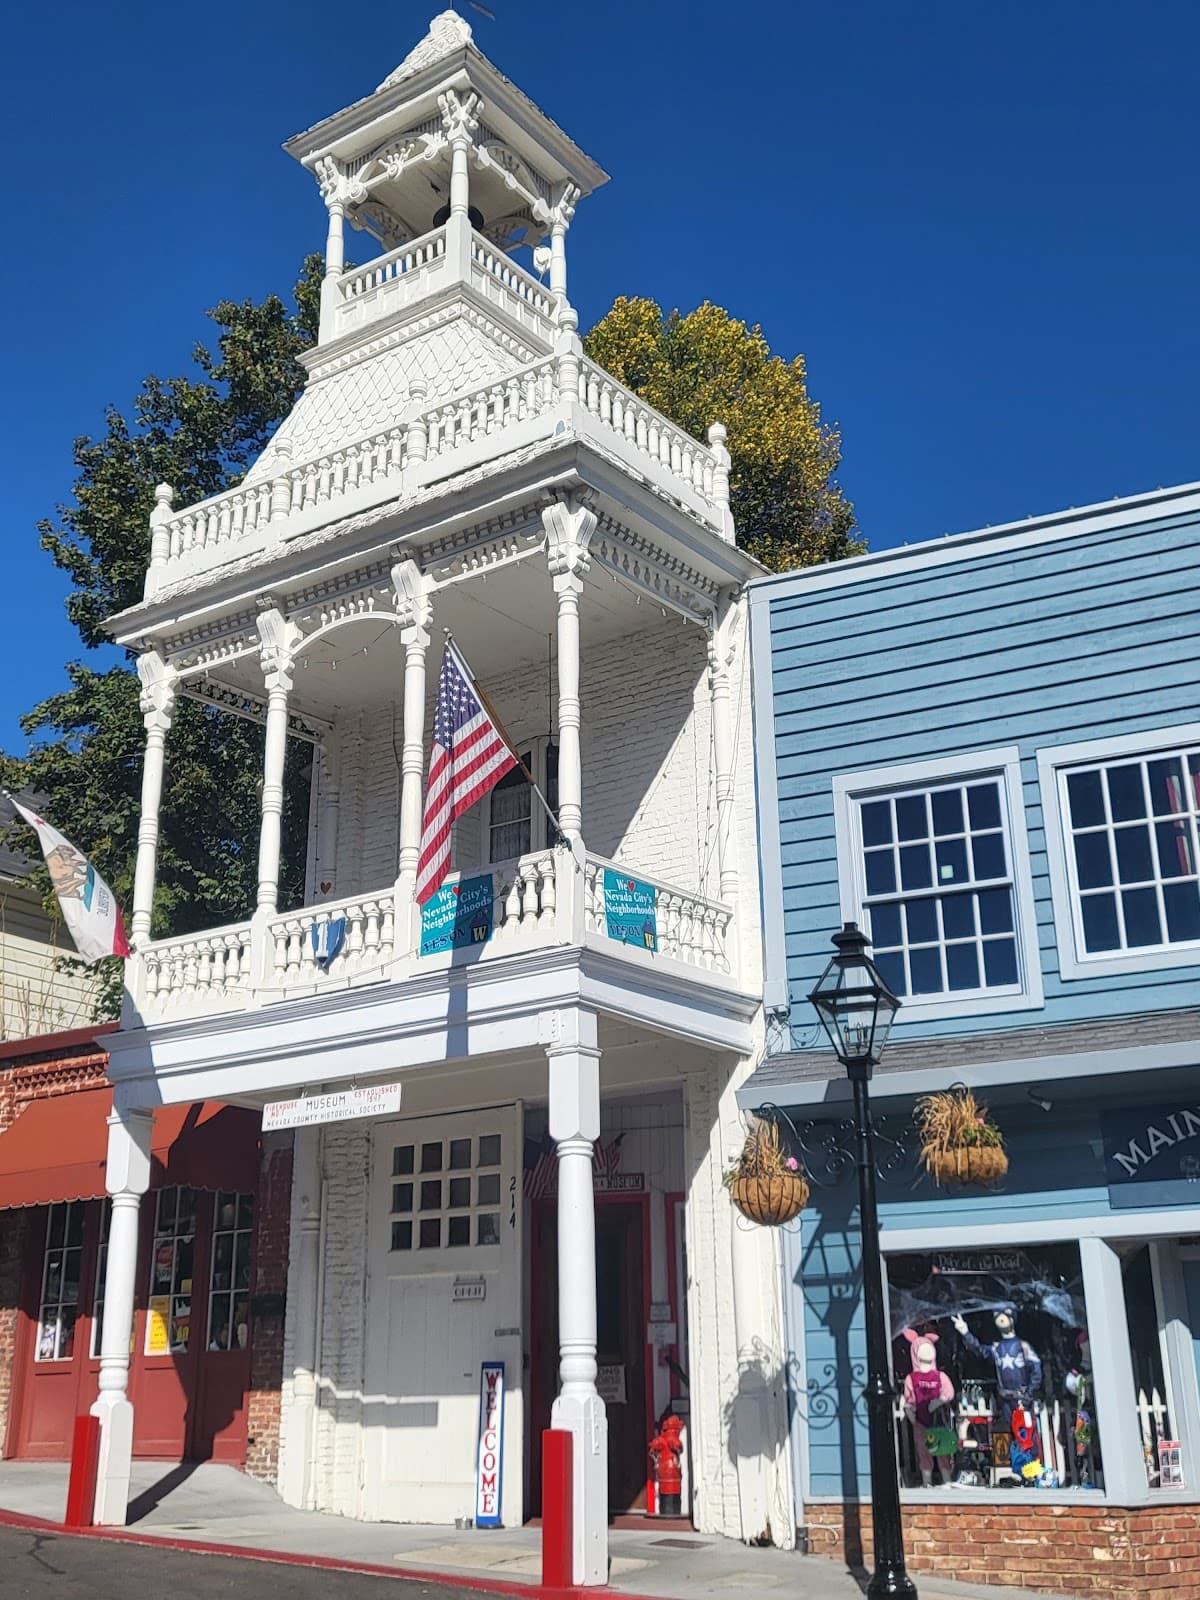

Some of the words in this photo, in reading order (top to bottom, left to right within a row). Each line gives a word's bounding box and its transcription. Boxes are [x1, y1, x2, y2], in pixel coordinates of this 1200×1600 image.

[616, 879, 628, 891] We
[423, 898, 458, 921] Nevada
[460, 885, 489, 903] City's
[438, 889, 453, 903] We
[605, 889, 633, 902] Nevada
[633, 892, 652, 905] City's
[423, 897, 492, 932] Neighborhoods
[606, 902, 655, 916] Neighborhoods
[473, 926, 487, 941] W
[610, 925, 627, 936] YES
[628, 925, 640, 936] ON
[424, 935, 448, 953] YES
[354, 1086, 398, 1098] ESTABLISHED
[306, 1095, 346, 1111] MUSEUM
[267, 1119, 291, 1127] NEVADA
[293, 1114, 318, 1124] COUNTY
[320, 1108, 356, 1120] HISTORICAL
[359, 1104, 386, 1113] SOCIETY
[481, 1371, 500, 1513] WELCOME
